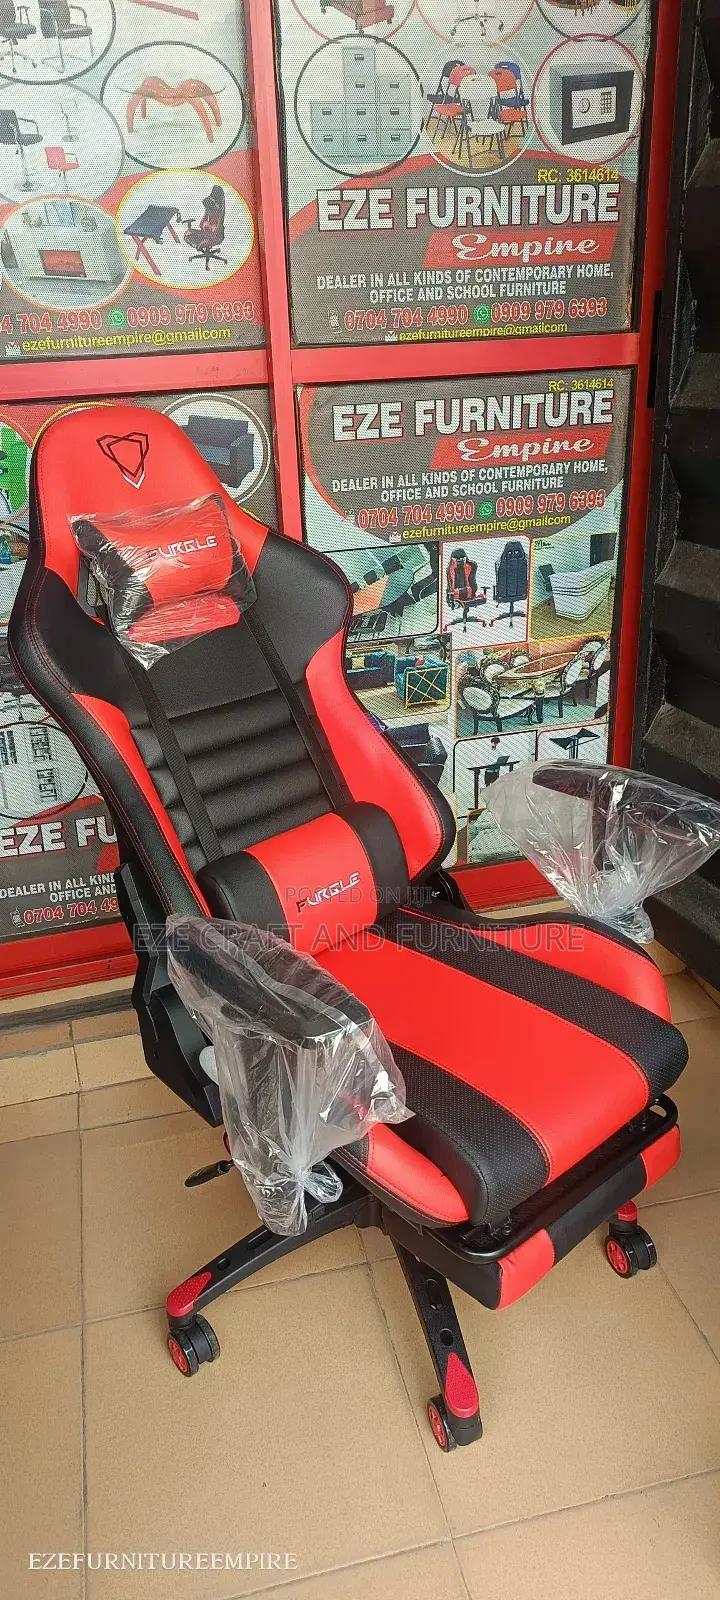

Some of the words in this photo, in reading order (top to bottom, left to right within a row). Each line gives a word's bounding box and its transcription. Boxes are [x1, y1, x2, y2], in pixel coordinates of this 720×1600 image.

[537, 169, 561, 183] RC:
[567, 168, 618, 183] 3614614
[316, 188, 393, 231] EZE
[405, 183, 620, 228] FURNITURE
[452, 233, 600, 263] Empire
[317, 274, 367, 290] DEALER
[370, 273, 383, 287] IN
[387, 272, 410, 287] ALL
[413, 270, 451, 285] KINDS
[455, 269, 471, 283] OF
[475, 265, 573, 282] CONTEMPORARY
[577, 263, 614, 279] HOME,
[370, 290, 414, 304] OFFICE
[417, 288, 443, 301] AND
[446, 285, 496, 300] SCHOOL
[500, 281, 566, 297] FURNITURE
[18, 312, 52, 333] 704
[57, 310, 102, 331] 4990
[127, 306, 170, 326] 0909
[176, 303, 207, 323] 979
[212, 301, 255, 322] 6393
[344, 310, 387, 331] 0704
[391, 308, 423, 327] 704
[427, 305, 469, 325] 4990
[491, 301, 531, 322] 0909
[535, 300, 564, 319] 979
[569, 297, 608, 318] 6393
[549, 380, 569, 392] RC:
[571, 378, 613, 390] 3614614
[332, 402, 402, 442] EZE
[415, 389, 614, 436] FURNITURE
[457, 436, 594, 461] Empire
[332, 476, 378, 493] DEALER
[381, 476, 393, 489] IN
[397, 474, 419, 488] ALL
[422, 472, 457, 486] KINDS
[461, 470, 475, 483] OF
[478, 463, 570, 481] CONTEMPORARY
[574, 460, 608, 474] HOME,
[380, 489, 422, 502] OFFICE
[425, 487, 448, 498] AND
[452, 483, 498, 497] SCHOOL
[502, 477, 563, 493] FURNITURE
[357, 508, 398, 529] 0704
[402, 505, 432, 525] 704
[435, 501, 474, 522] 4990
[495, 497, 534, 517] 0909
[538, 494, 565, 513] 979
[569, 490, 606, 510] 6393
[0, 822, 66, 857] EZE
[0, 883, 46, 898] DEALER
[49, 881, 62, 891] IN
[65, 877, 86, 888] ALL
[50, 889, 91, 902] OFFICE
[24, 905, 64, 925] 0704
[67, 901, 97, 917] 704
